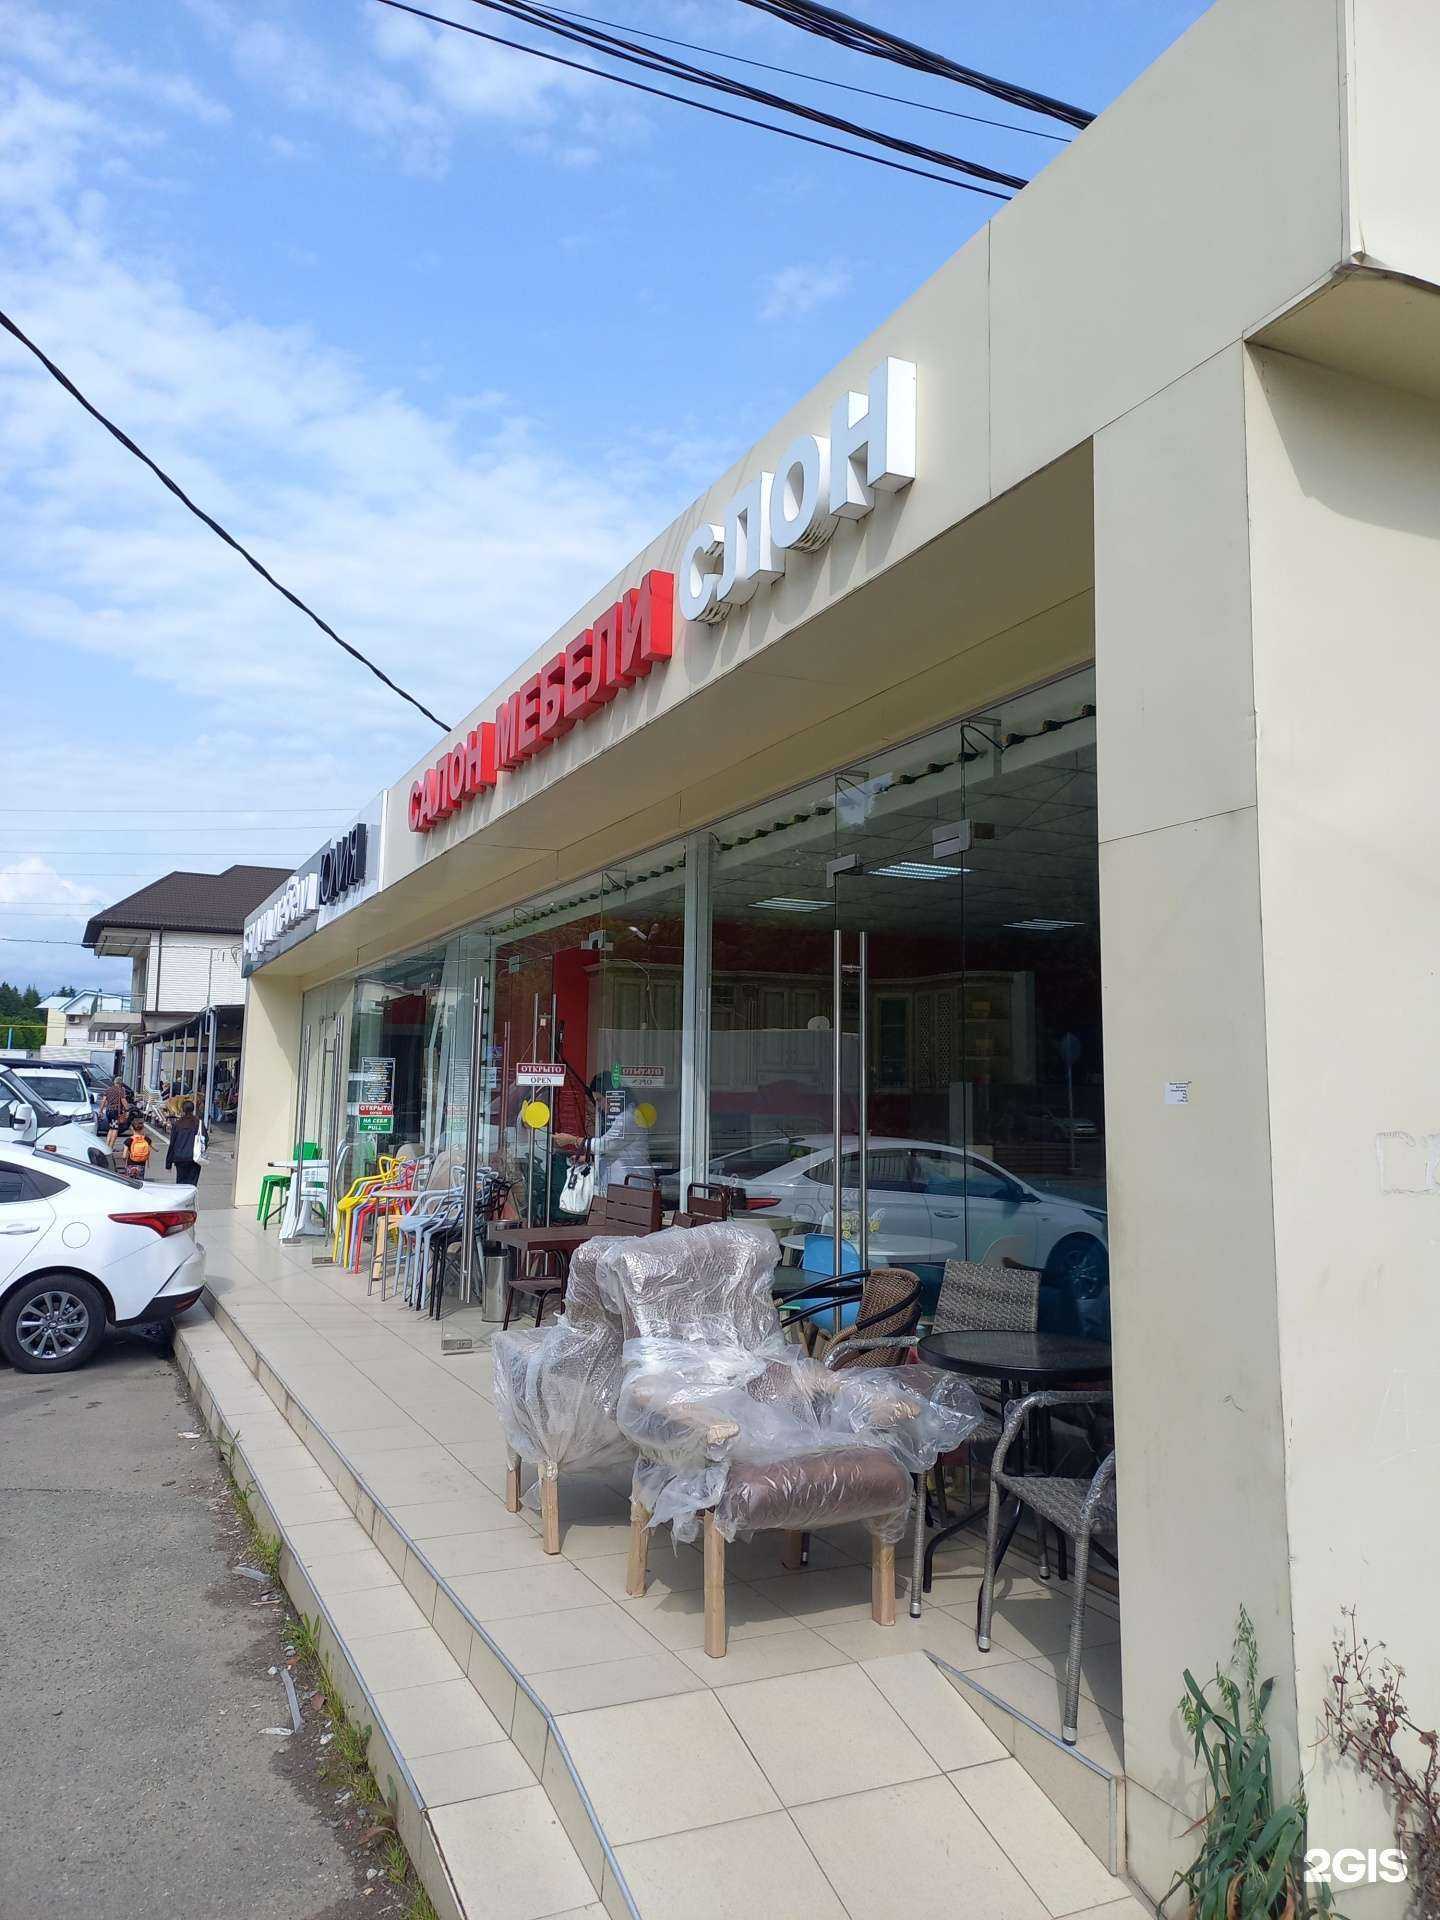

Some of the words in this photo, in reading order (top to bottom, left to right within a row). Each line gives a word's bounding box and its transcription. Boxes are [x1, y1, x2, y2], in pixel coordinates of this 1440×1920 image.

[408, 721, 497, 832] САЛОН
[496, 569, 675, 771] МЕБЕЛИ
[679, 356, 917, 626] СЛОН
[521, 1065, 562, 1073] ОТКРЫТО
[530, 1076, 552, 1084] OPEN
